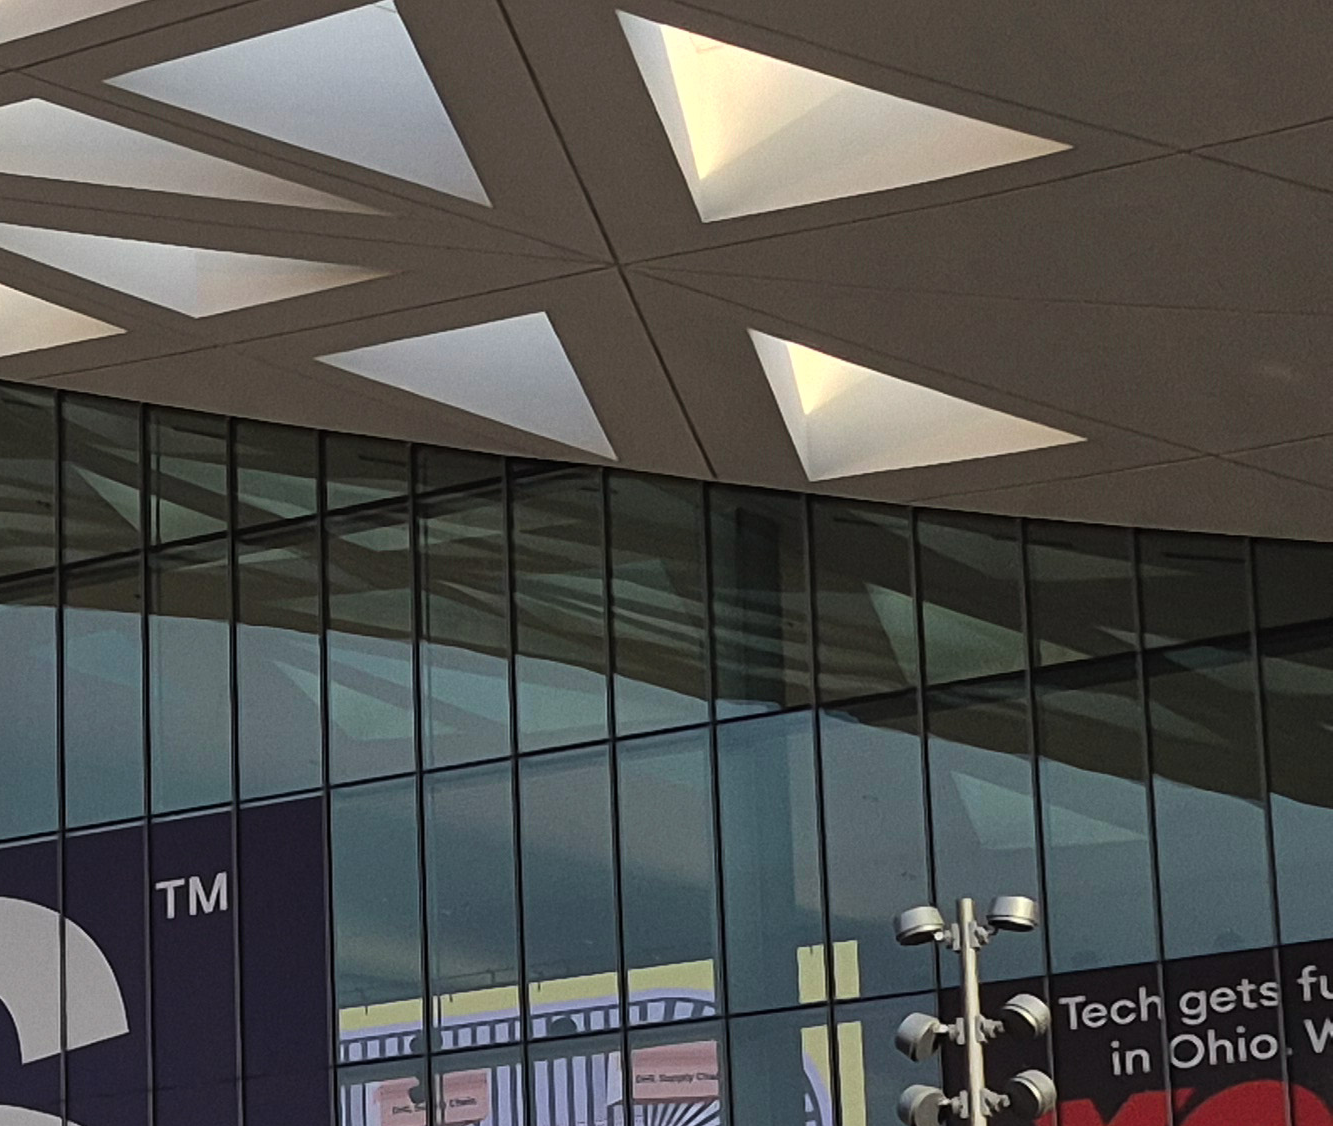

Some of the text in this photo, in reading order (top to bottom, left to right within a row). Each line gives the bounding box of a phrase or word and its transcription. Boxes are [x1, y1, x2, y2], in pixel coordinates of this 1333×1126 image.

[155, 871, 228, 919] TM
[1058, 986, 1163, 1030] Tech
[1179, 979, 1280, 1025] gets
[1111, 1041, 1151, 1076] in
